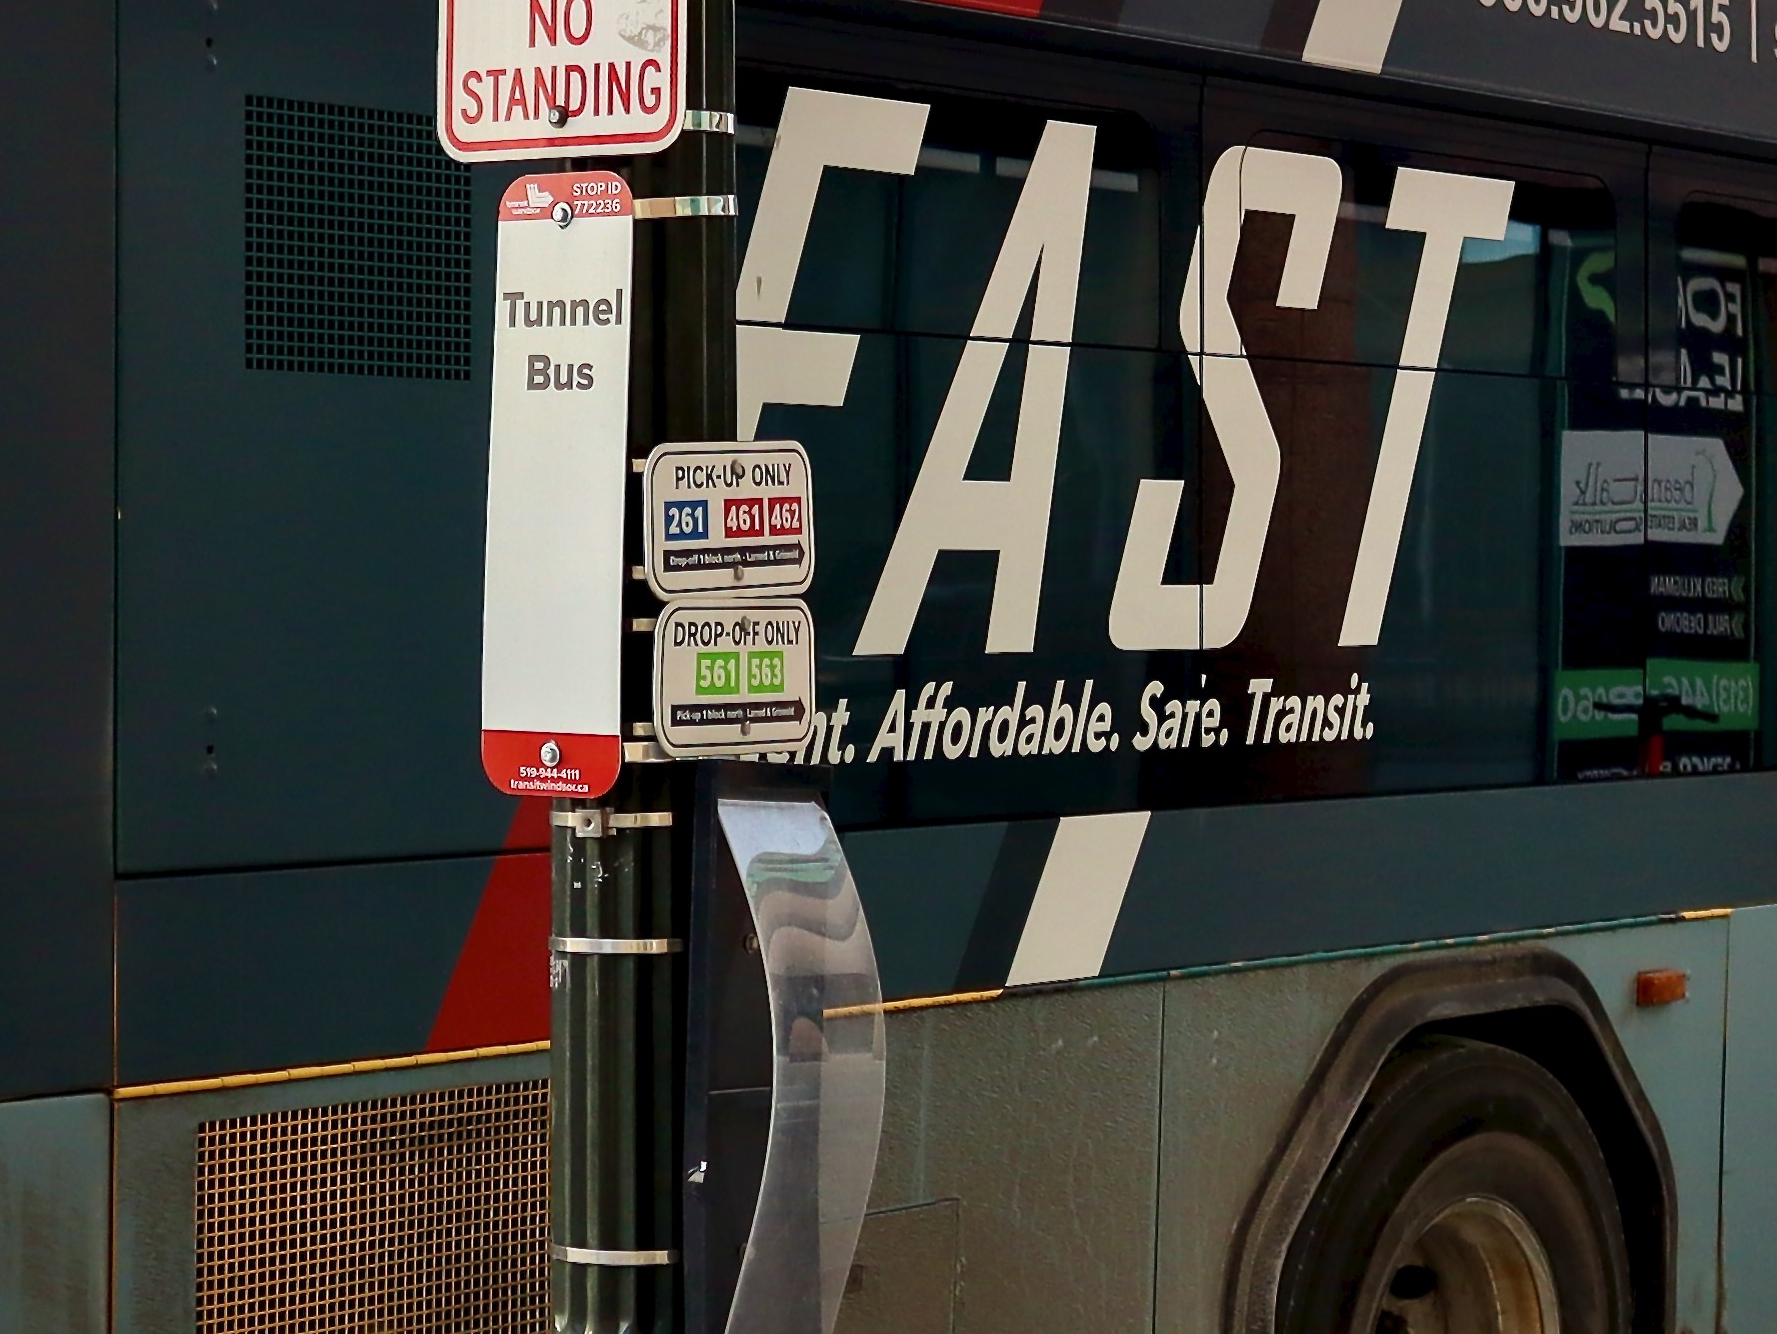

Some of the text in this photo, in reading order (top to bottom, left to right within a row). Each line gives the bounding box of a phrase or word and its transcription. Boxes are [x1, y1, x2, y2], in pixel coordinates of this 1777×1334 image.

[460, 58, 662, 124] STANDING
[572, 181, 622, 196] STOP ID
[573, 199, 621, 215] 772236
[502, 288, 624, 330] Tunnel
[525, 355, 595, 392] Bus
[736, 85, 1516, 656] FAST
[674, 462, 792, 490] PICK-UP ONLY
[668, 502, 800, 535] 261 461 462
[673, 620, 801, 647] DROP-OFF ONLY
[699, 657, 782, 688] 561 563
[867, 679, 1120, 765] Affordable.
[1132, 673, 1228, 753] Safe.
[1244, 671, 1375, 747] Transit.
[510, 778, 589, 793] transitwindsor.ca
[519, 766, 580, 781] 519-944-4111
